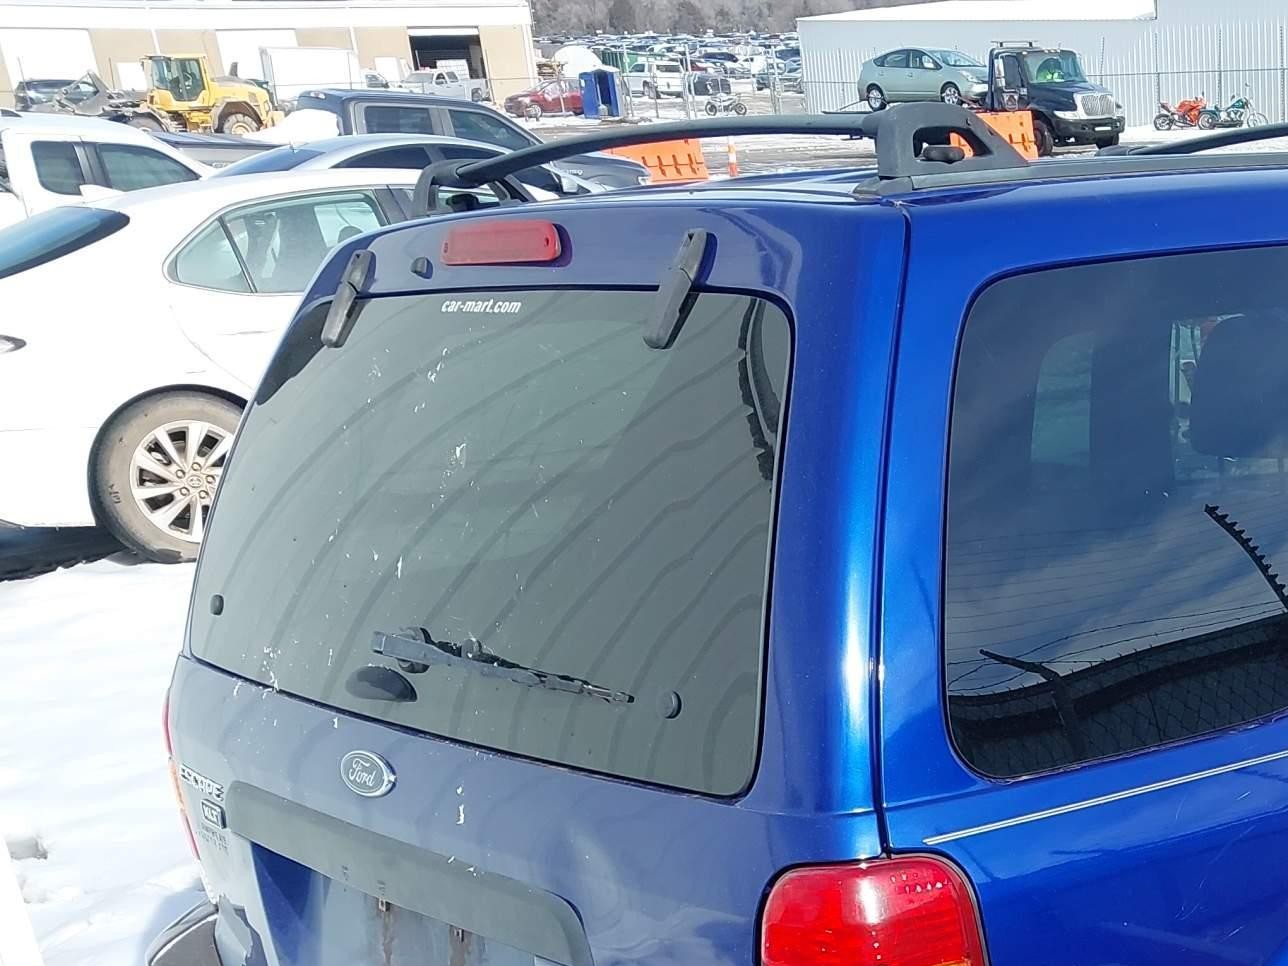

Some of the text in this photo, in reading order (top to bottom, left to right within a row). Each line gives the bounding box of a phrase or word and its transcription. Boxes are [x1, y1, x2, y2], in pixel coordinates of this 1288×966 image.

[441, 299, 521, 313] car-mart.com
[180, 764, 225, 802] ESCAPE
[348, 758, 377, 787] Ford
